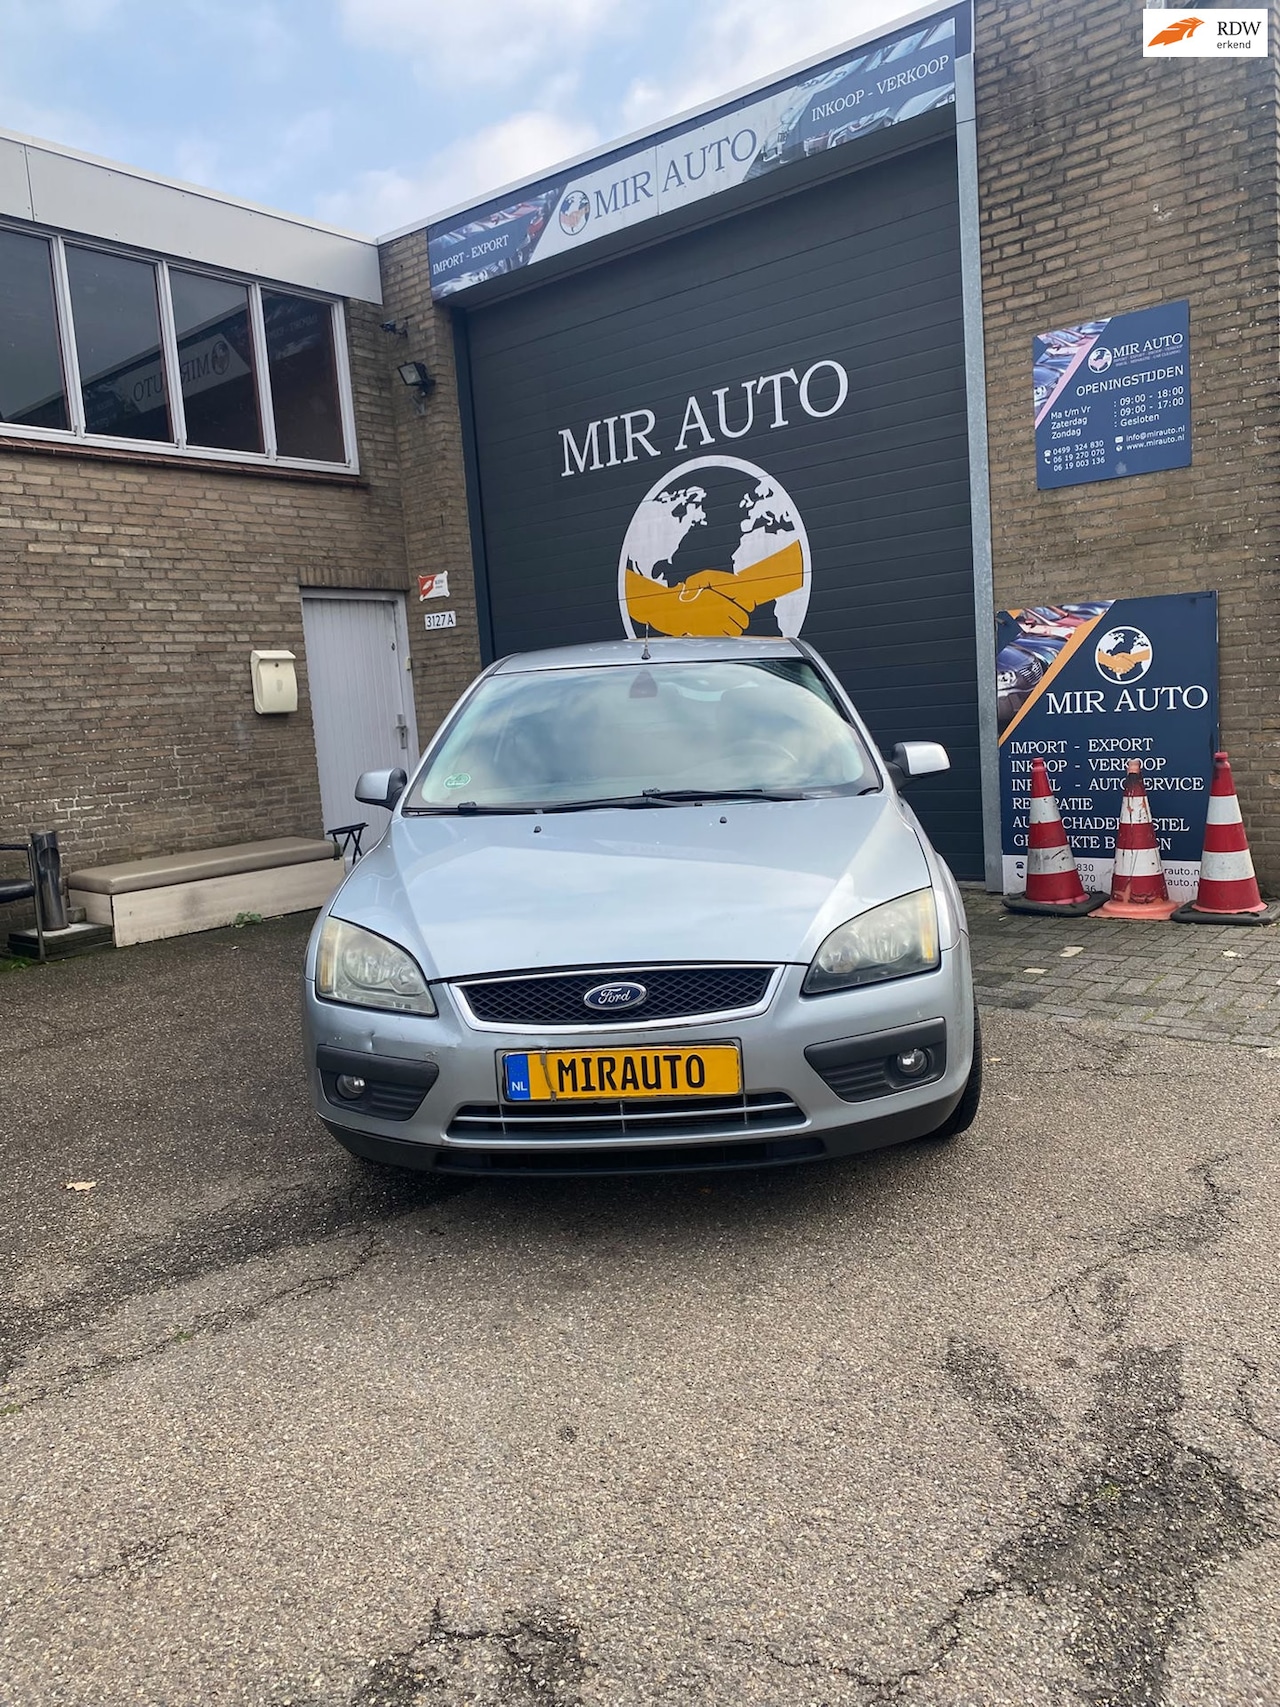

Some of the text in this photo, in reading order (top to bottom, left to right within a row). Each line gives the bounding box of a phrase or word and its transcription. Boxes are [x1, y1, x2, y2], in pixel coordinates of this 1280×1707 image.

[811, 89, 865, 122] INKOOP
[876, 55, 949, 95] VERKOOP
[593, 128, 757, 220] MIR AUTO
[432, 255, 464, 275] IMPORT
[471, 234, 510, 259] EXPORT
[1113, 342, 1140, 358] MIR
[1143, 332, 1184, 352] AUTO
[1076, 364, 1184, 397] OPENINGSTIJDEN
[558, 359, 849, 477] MIR AUTO
[1051, 411, 1063, 420] Ma
[1081, 405, 1092, 414] Vr
[1120, 394, 1146, 406] 09:00
[1157, 386, 1184, 399] 18:00
[1051, 417, 1088, 430] Zaterdag
[1120, 404, 1146, 417] 09:00
[1157, 396, 1184, 410] 17:00
[1051, 428, 1082, 440] Zondag
[1120, 413, 1160, 427] Gesloten
[1126, 433, 1185, 450] www.mirauto.nl
[1046, 685, 1209, 715] MIR AUTO
[1010, 740, 1068, 754] IMPORT
[1088, 737, 1154, 752] EXPORT
[1011, 759, 1068, 773] INKOP
[597, 987, 631, 1005] Ford
[511, 1081, 528, 1092] NL
[557, 1054, 706, 1093] MIRAUTO
